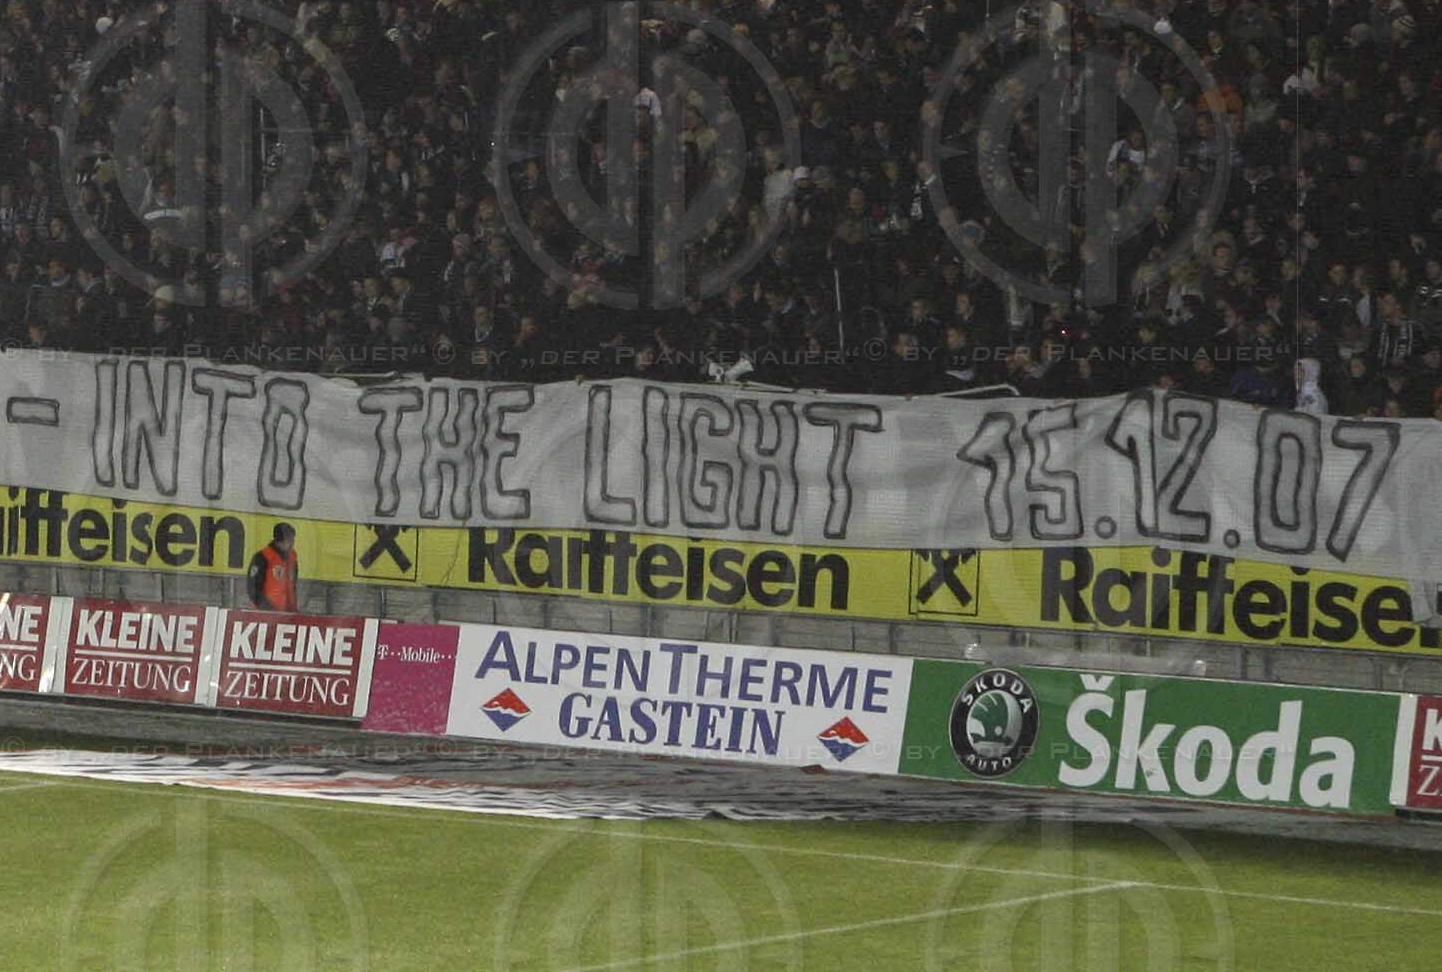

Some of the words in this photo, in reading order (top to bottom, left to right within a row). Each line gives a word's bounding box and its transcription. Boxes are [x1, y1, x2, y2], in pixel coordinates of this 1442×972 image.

[92, 357, 310, 511] INTO
[358, 384, 535, 521] THE
[584, 384, 886, 541] LIGHT
[956, 387, 1402, 563] 15.12.07
[467, 526, 850, 612] Raiffeisen
[1040, 546, 1442, 650] Raiffeise
[75, 608, 200, 654] KLEINE
[229, 620, 358, 667] KLEINE
[71, 657, 192, 695] ZEITUNG
[224, 669, 351, 707] ZEITUNG
[558, 691, 786, 756] GASTEIN
[1058, 673, 1356, 809] Škoda
